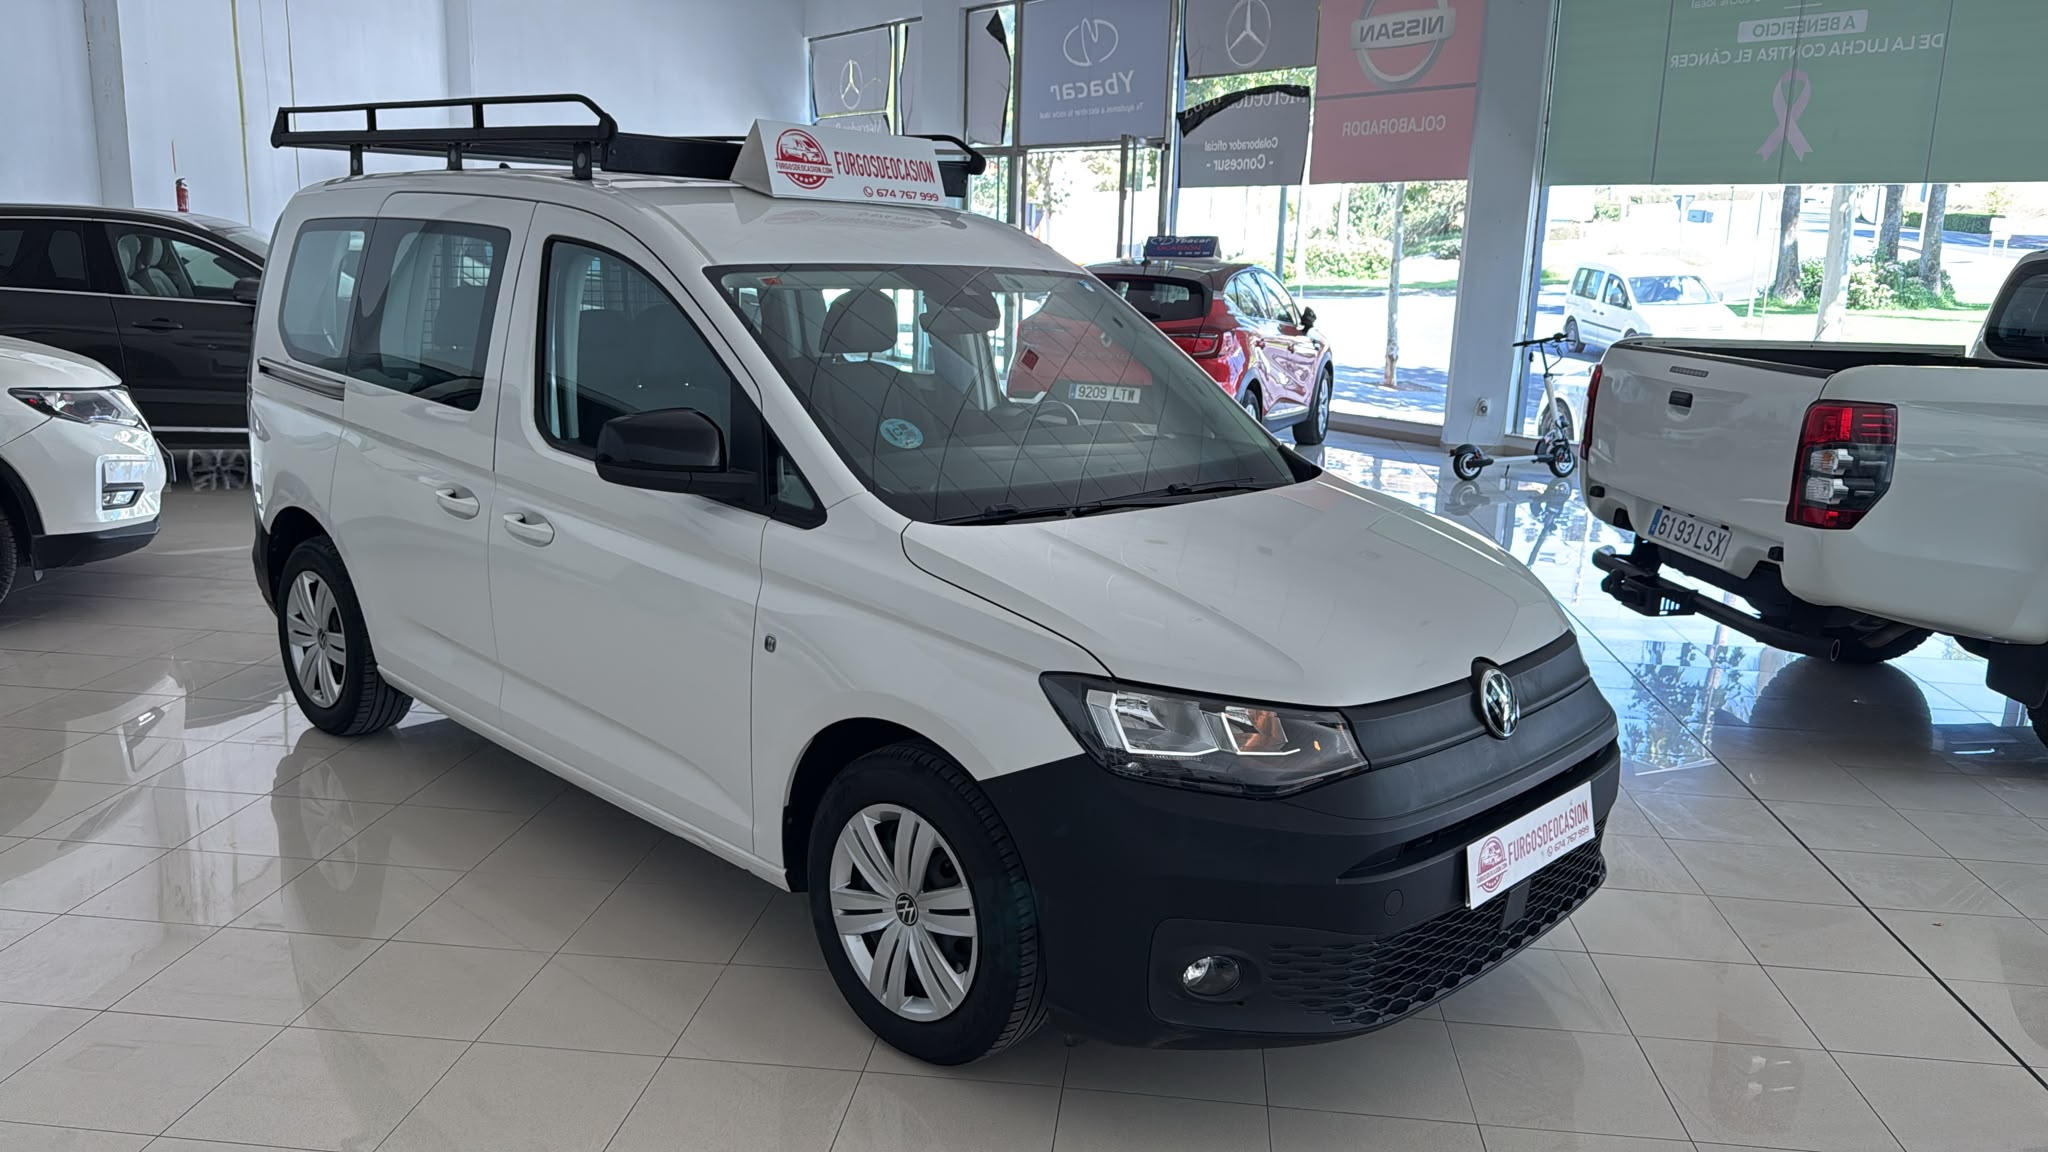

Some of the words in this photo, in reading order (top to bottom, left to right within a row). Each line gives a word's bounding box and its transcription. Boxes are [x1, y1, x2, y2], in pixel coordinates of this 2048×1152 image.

[834, 151, 936, 184] FURGOSDEOCASION
[877, 188, 896, 198] 674
[899, 190, 917, 200] 767
[920, 192, 939, 202] 999
[1078, 385, 1107, 399] 9209
[1112, 388, 1136, 401] LTW
[1658, 514, 1695, 544] 6193
[1693, 526, 1727, 557] LSX
[1508, 799, 1589, 865] FURGOSDEOCASION
[1554, 838, 1565, 852] 674
[1566, 831, 1577, 845] 767
[1578, 825, 1589, 838] 999
